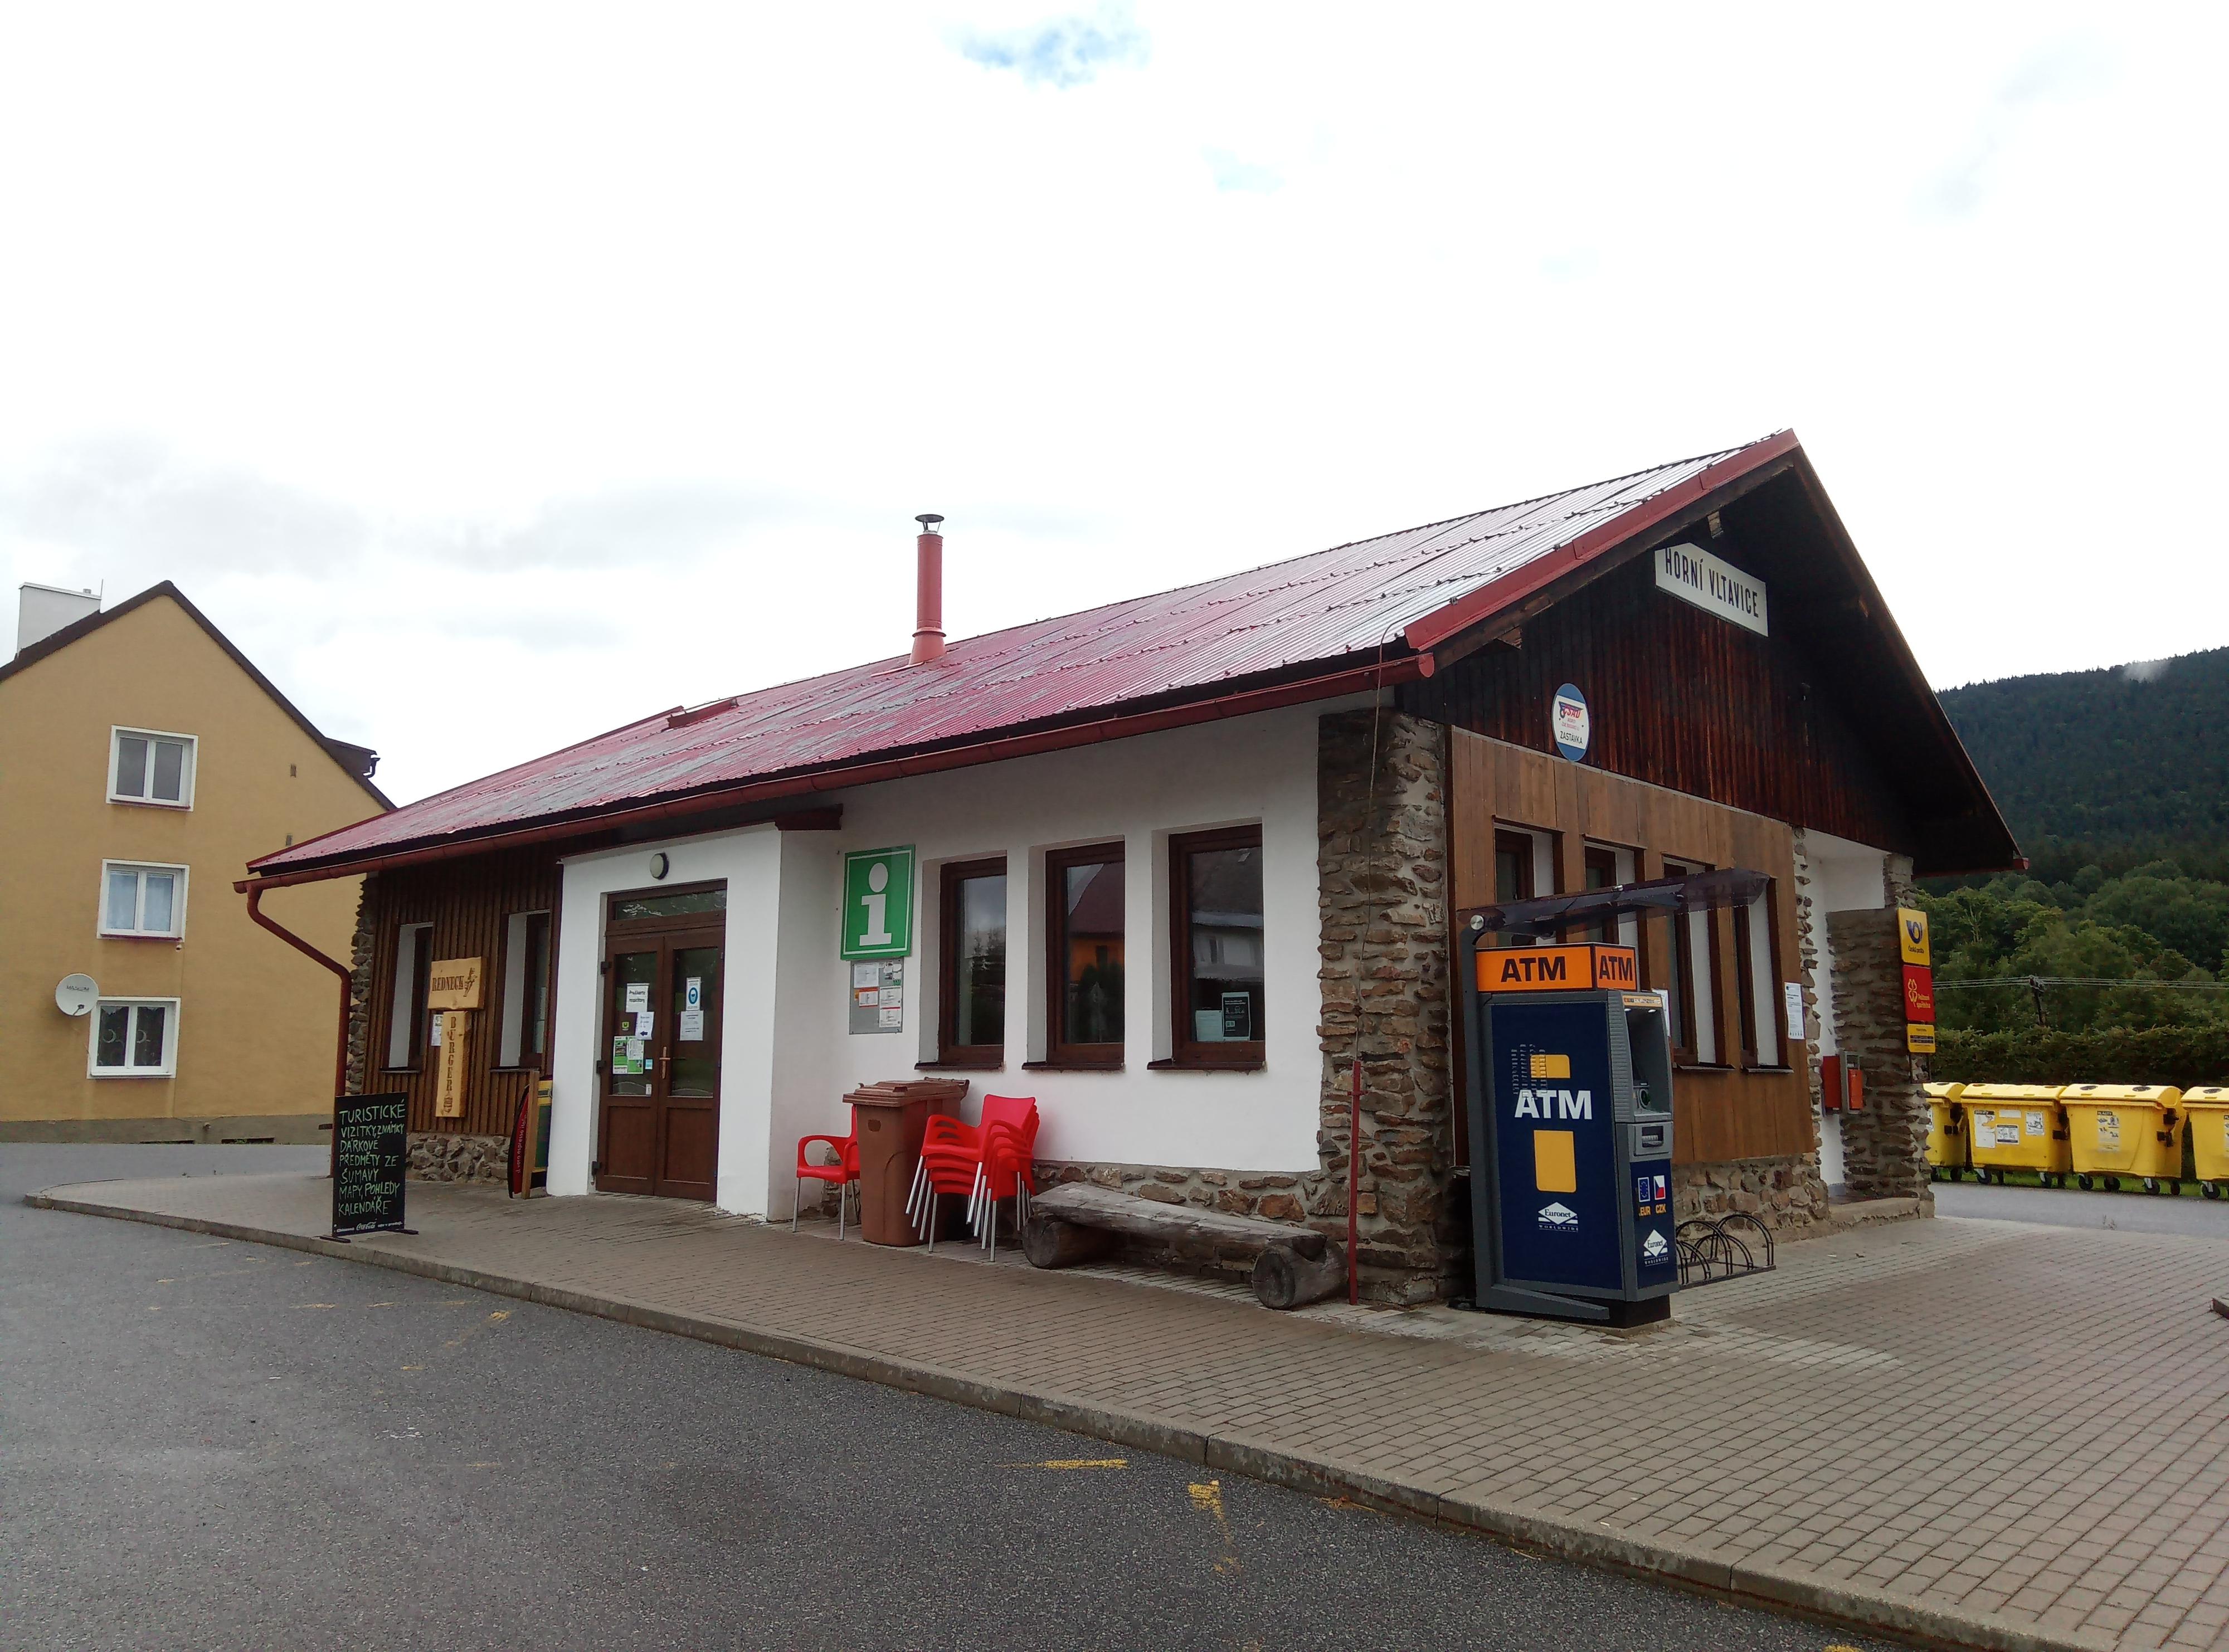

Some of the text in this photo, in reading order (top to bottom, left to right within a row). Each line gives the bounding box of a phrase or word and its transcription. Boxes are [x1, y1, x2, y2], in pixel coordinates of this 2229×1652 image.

[1665, 547, 1759, 618] HORNÍ VLTAVICE
[1560, 730, 1583, 745] ZASTÁVKA
[1500, 955, 1567, 983] ATM
[1599, 954, 1633, 982] ATM
[432, 976, 464, 992] REDNECK
[446, 1016, 457, 1091] BURGER
[339, 1098, 406, 1125] TURISTICKÉ
[1514, 1089, 1593, 1120] ATM
[377, 1120, 405, 1135] ZNÁMKY
[340, 1136, 380, 1153] DÁRKOVÉ
[339, 1151, 399, 1167] PŘEDMĚTY ZE
[340, 1168, 379, 1185] ŠUMAVY
[339, 1180, 400, 1200] MAPY, POHLEDY
[338, 1195, 392, 1217] KALENDÁŘE
[1544, 1208, 1571, 1219] Euronet
[1639, 1203, 1667, 1216] EUR CZK
[1647, 1239, 1664, 1249] Euronet
[1644, 1256, 1669, 1265] WORLDWIDE
